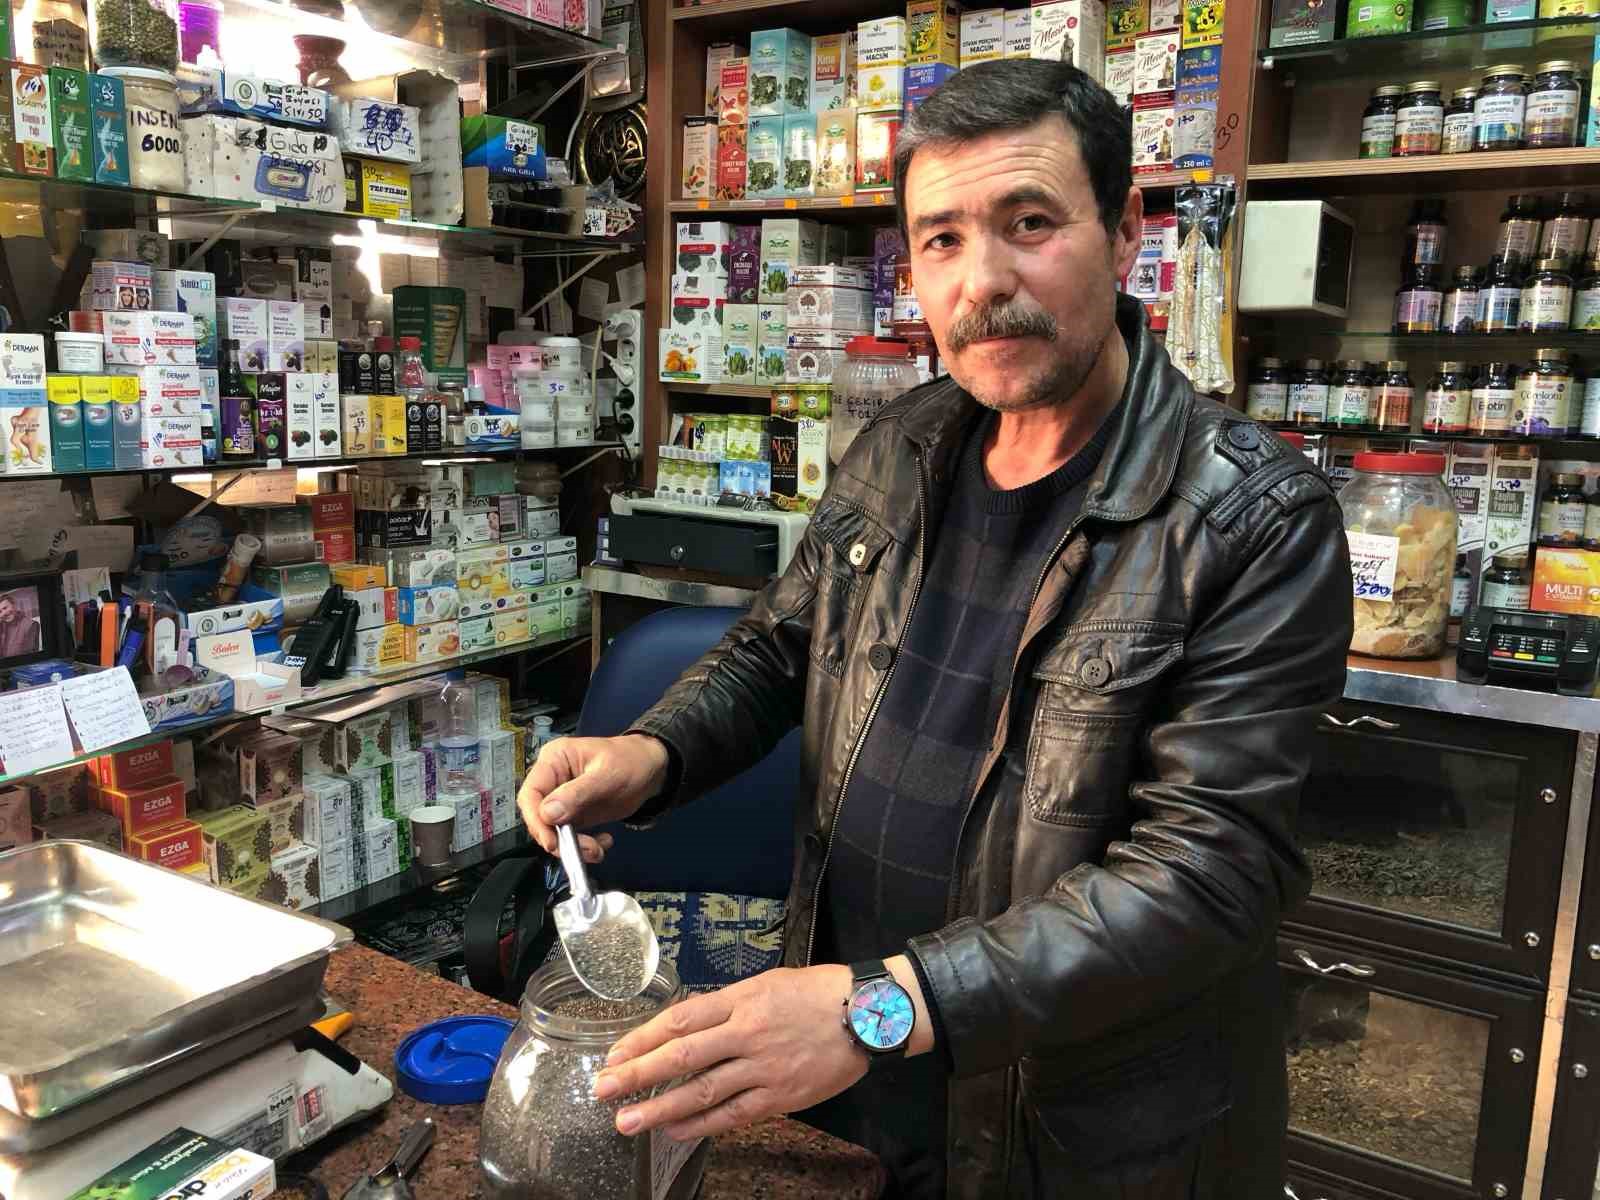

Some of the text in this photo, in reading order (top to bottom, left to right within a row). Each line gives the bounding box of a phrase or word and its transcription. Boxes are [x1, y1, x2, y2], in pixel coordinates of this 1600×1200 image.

[1200, 9, 1215, 25] 65
[969, 44, 994, 53] MACUN
[865, 53, 889, 62] MACUN
[12, 344, 39, 352] DERMAN
[1545, 584, 1583, 594] MULTI
[129, 751, 160, 767] EZGA
[143, 796, 173, 812] EZGA
[160, 840, 190, 858] EZGA
